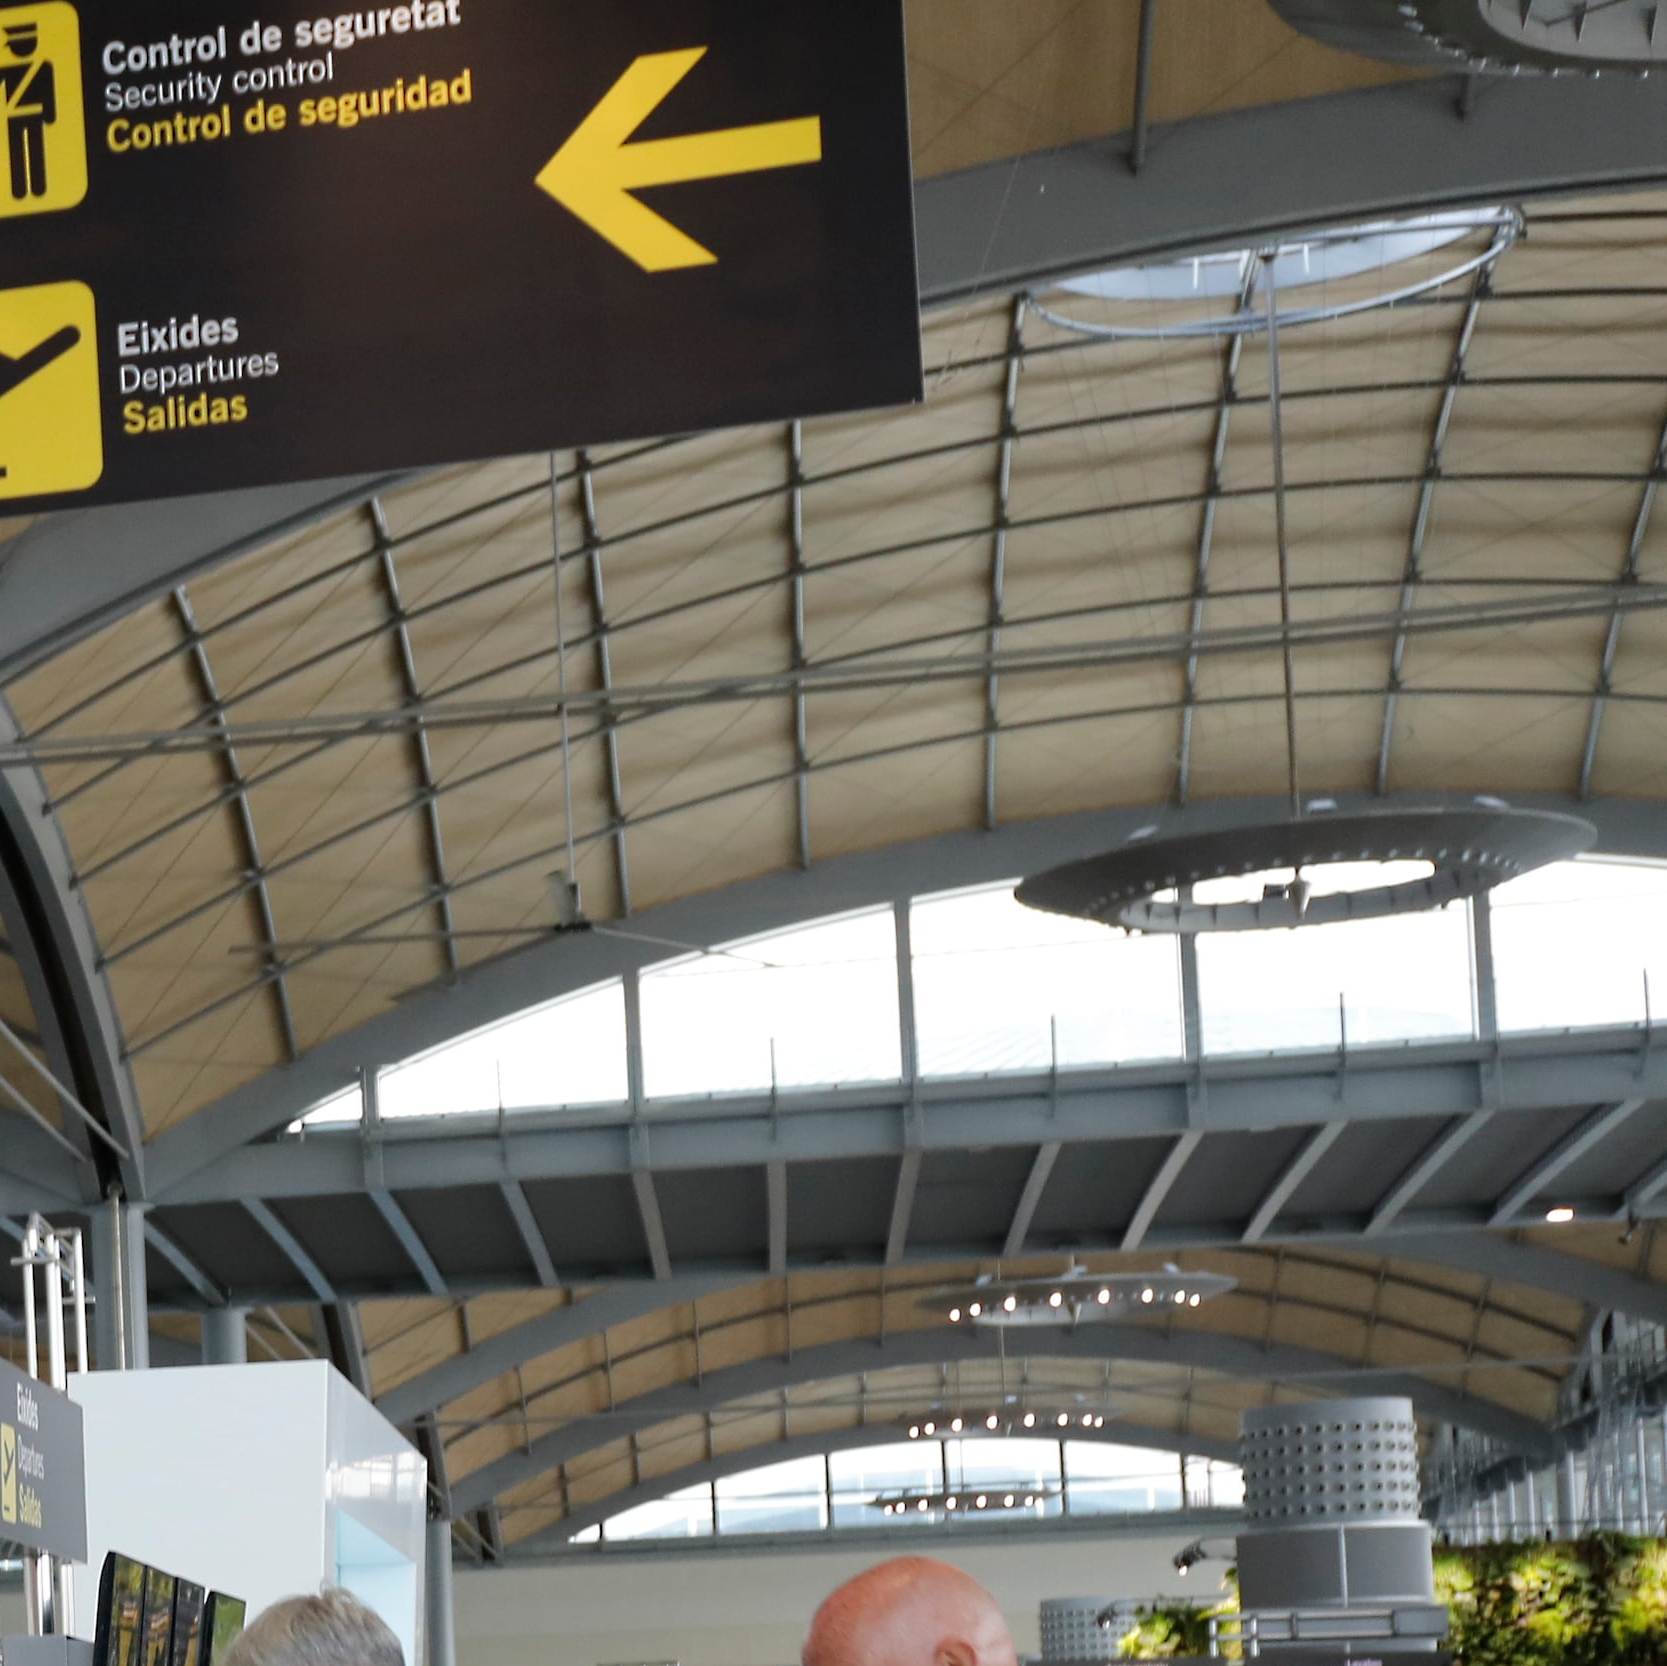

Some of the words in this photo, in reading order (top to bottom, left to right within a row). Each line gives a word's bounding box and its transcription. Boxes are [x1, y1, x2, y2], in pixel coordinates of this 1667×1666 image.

[102, 25, 227, 75] Control
[239, 20, 283, 55] de
[294, 0, 462, 50] seguretat
[105, 72, 222, 112] Security
[232, 51, 334, 94] control
[106, 104, 231, 152] Control
[243, 99, 286, 134] de
[299, 68, 472, 129] seguridad
[117, 313, 240, 357] Eixides
[120, 351, 280, 395] Departures
[123, 392, 248, 435] Salidas
